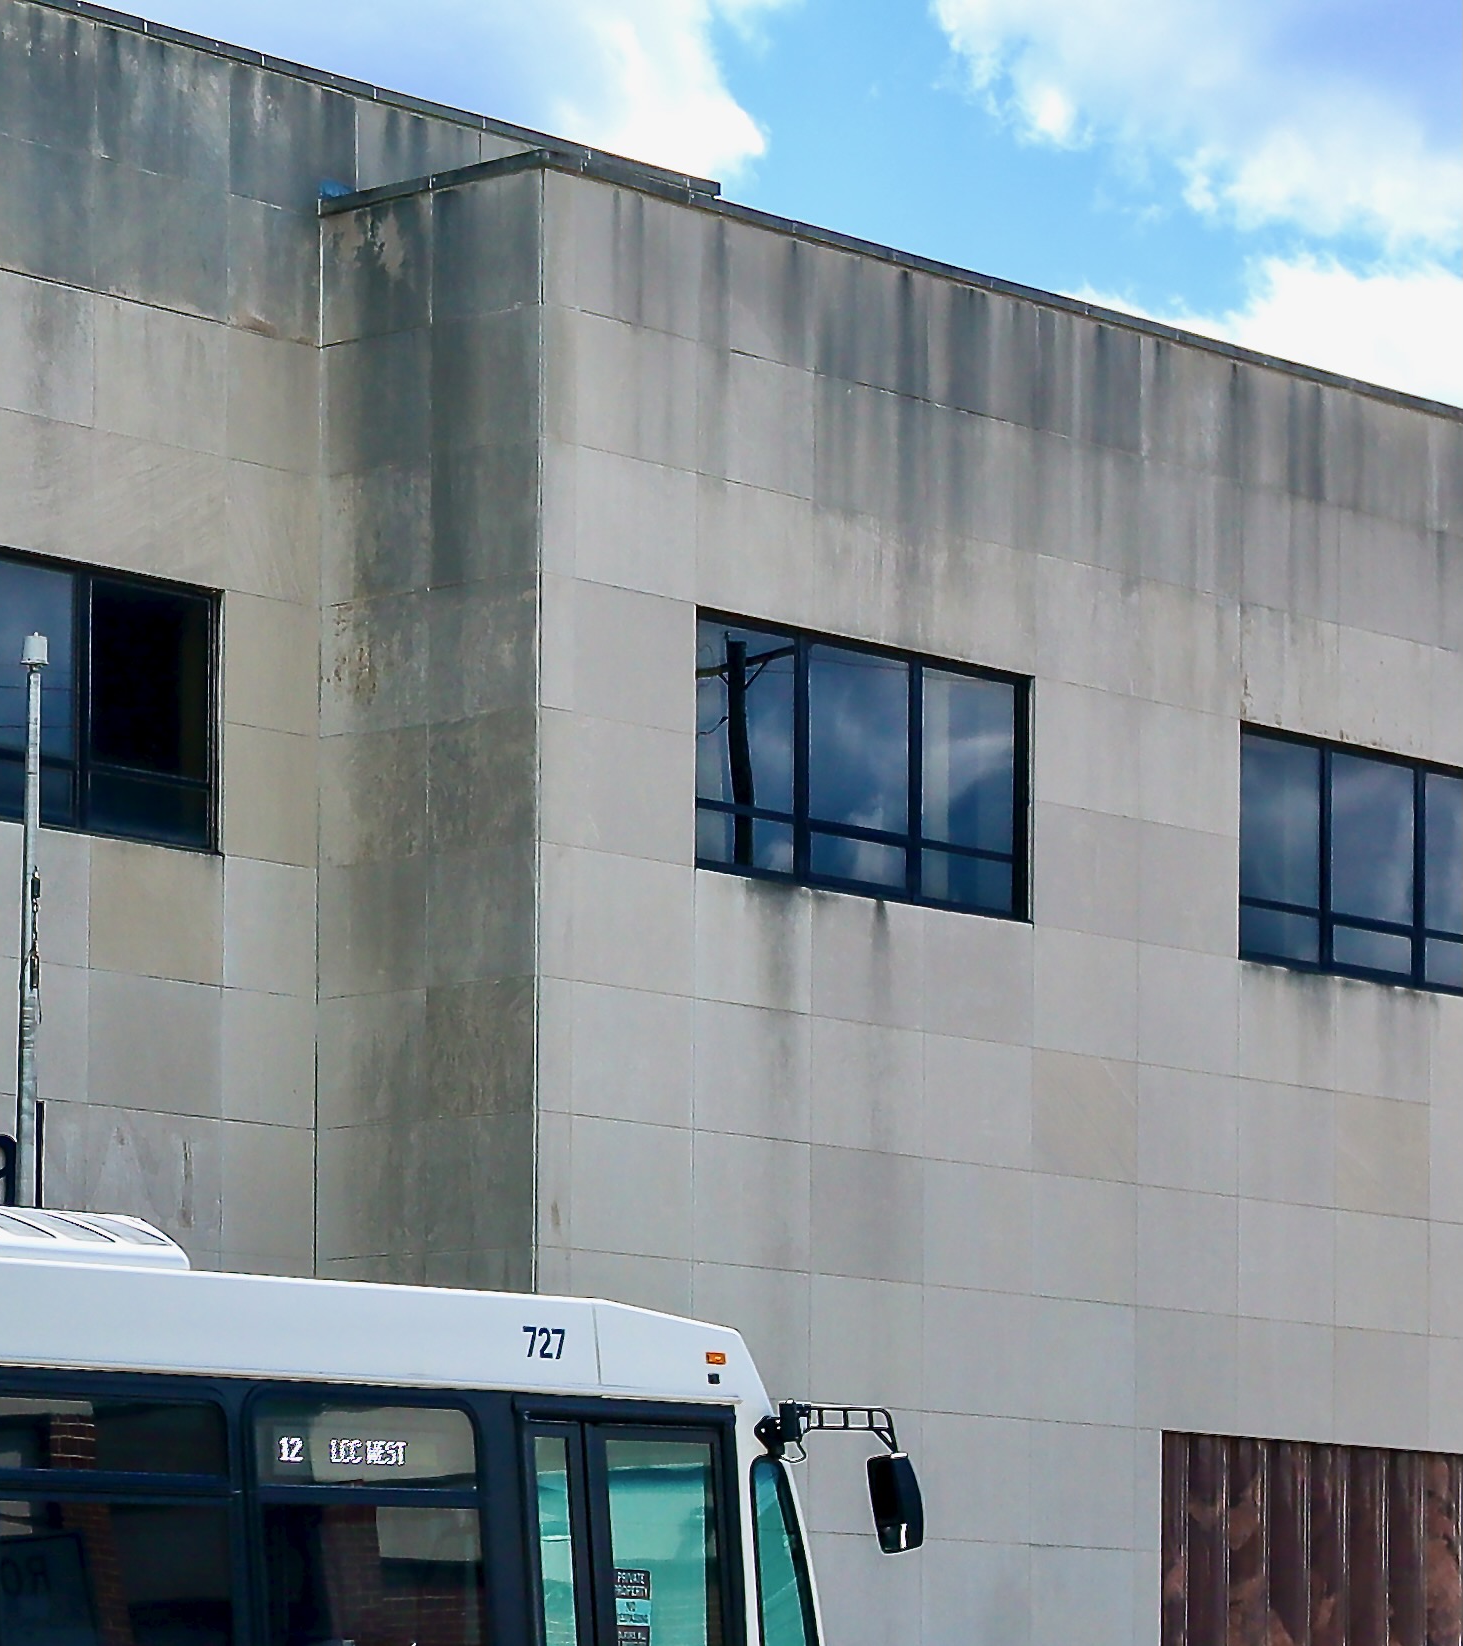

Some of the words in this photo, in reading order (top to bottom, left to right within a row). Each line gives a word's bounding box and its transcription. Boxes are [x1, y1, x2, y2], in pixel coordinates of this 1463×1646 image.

[522, 1325, 565, 1359] 727
[278, 1436, 304, 1462] 12
[366, 1440, 408, 1466] WEST
